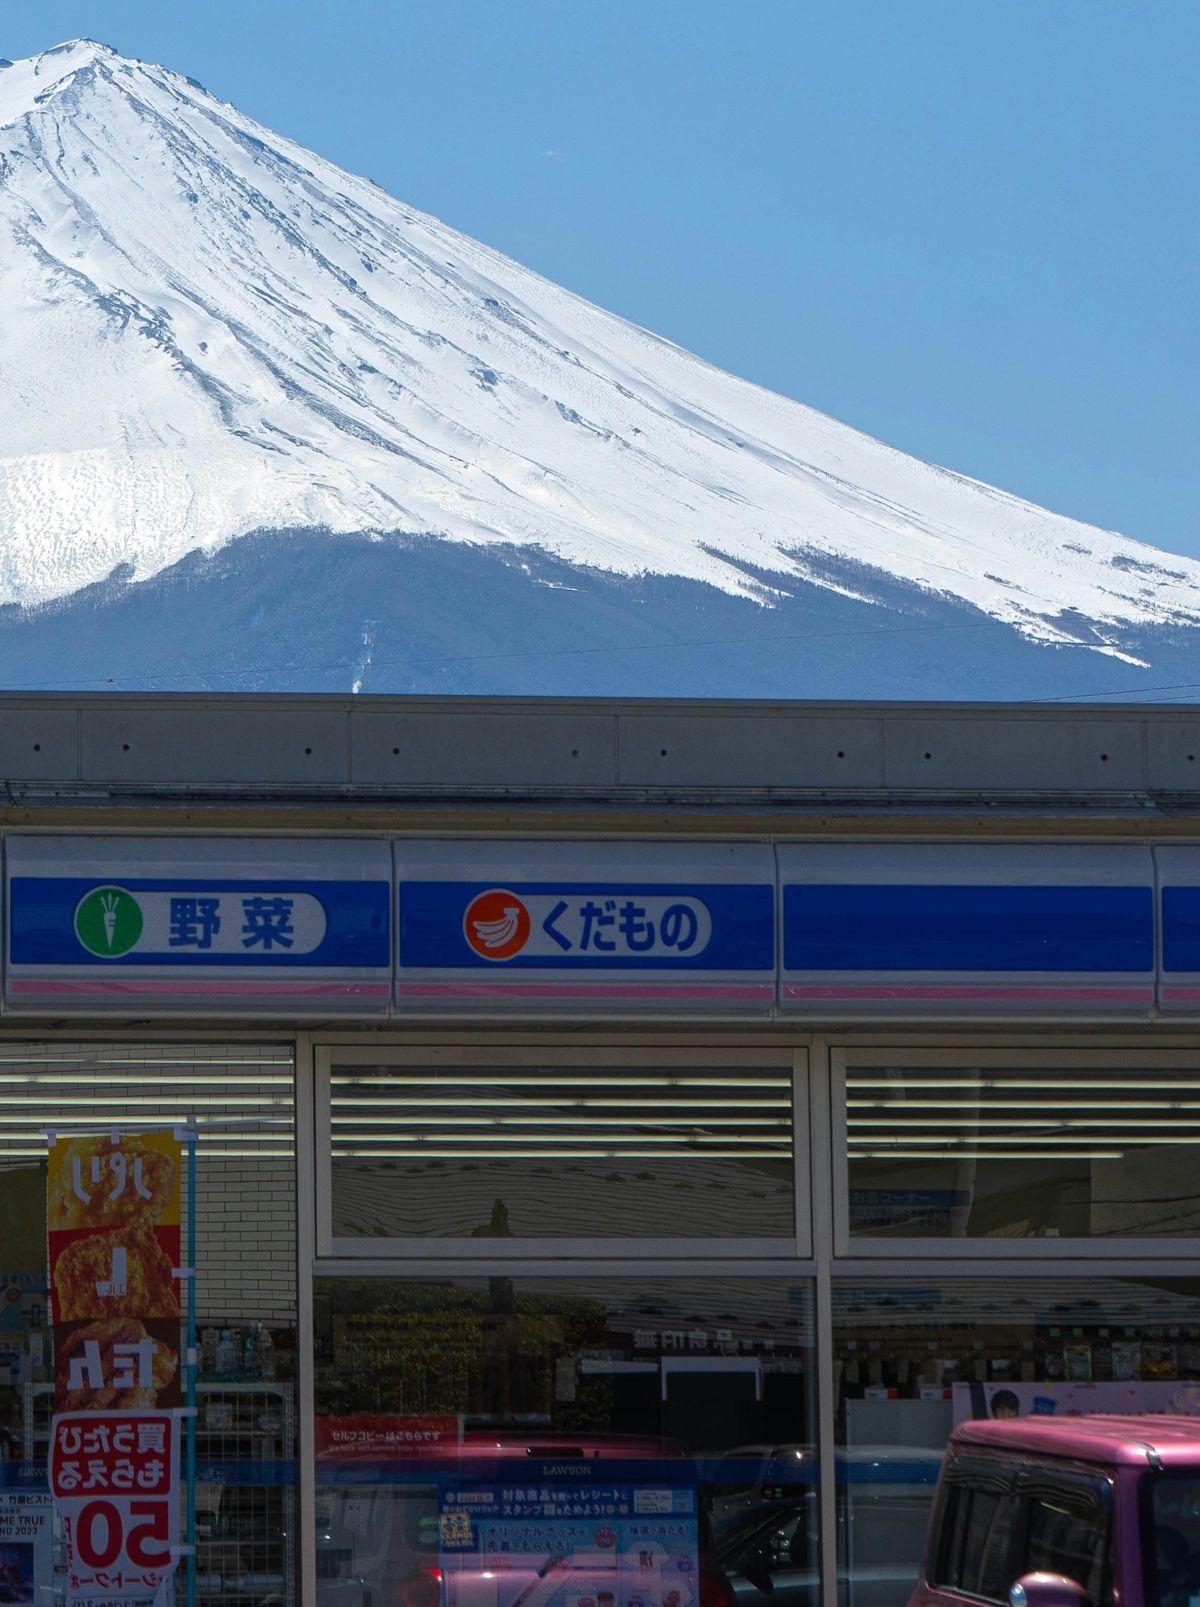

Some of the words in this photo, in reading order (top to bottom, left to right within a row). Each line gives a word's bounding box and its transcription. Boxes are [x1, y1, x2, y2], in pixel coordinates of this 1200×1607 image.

[168, 895, 295, 950] 野菜
[541, 899, 698, 953] くだもの
[331, 1431, 440, 1441] セルフコピーはこちらです
[543, 1465, 592, 1476] LAWSON
[8, 1495, 49, 1505] 竹原ピスト
[17, 1516, 46, 1526] TRUE
[15, 1527, 38, 1536] 2023
